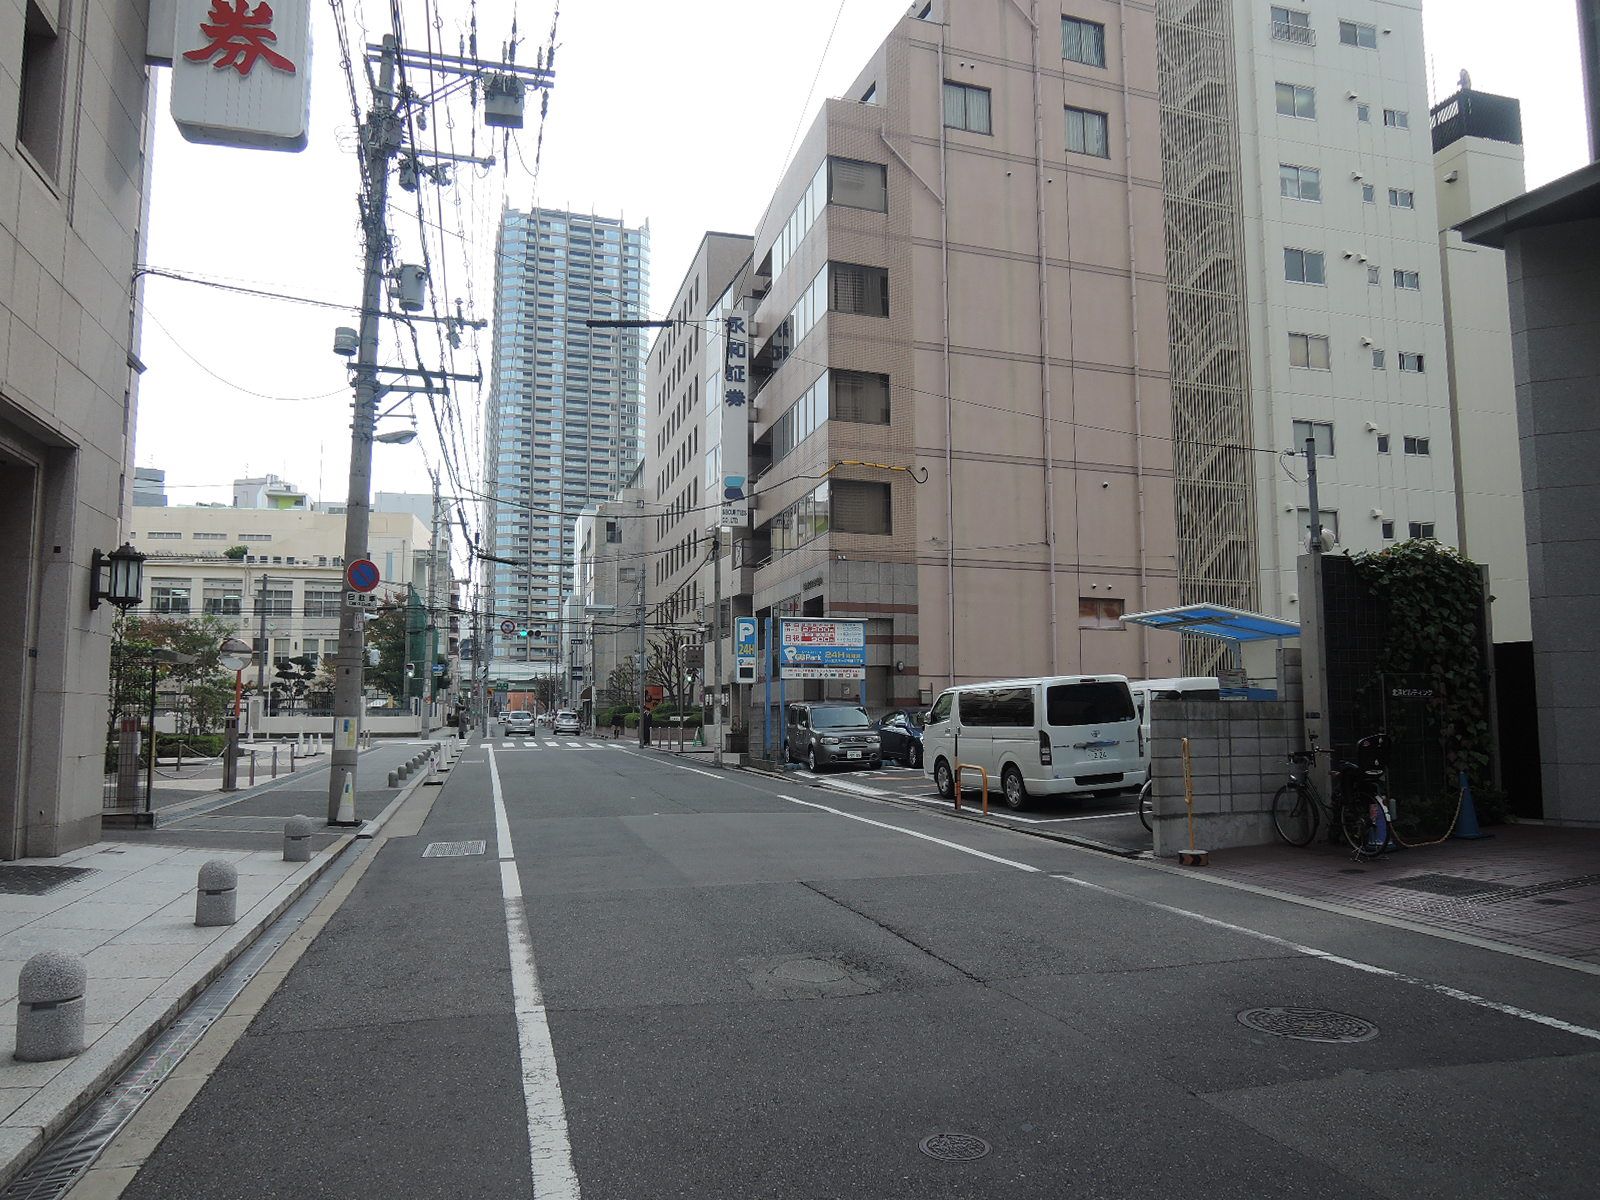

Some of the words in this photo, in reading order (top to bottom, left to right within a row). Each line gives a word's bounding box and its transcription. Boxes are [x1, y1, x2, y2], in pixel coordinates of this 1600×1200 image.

[182, 0, 296, 75] 券
[724, 316, 746, 407] 永和証券
[738, 644, 754, 655] 24H
[739, 622, 755, 642] P
